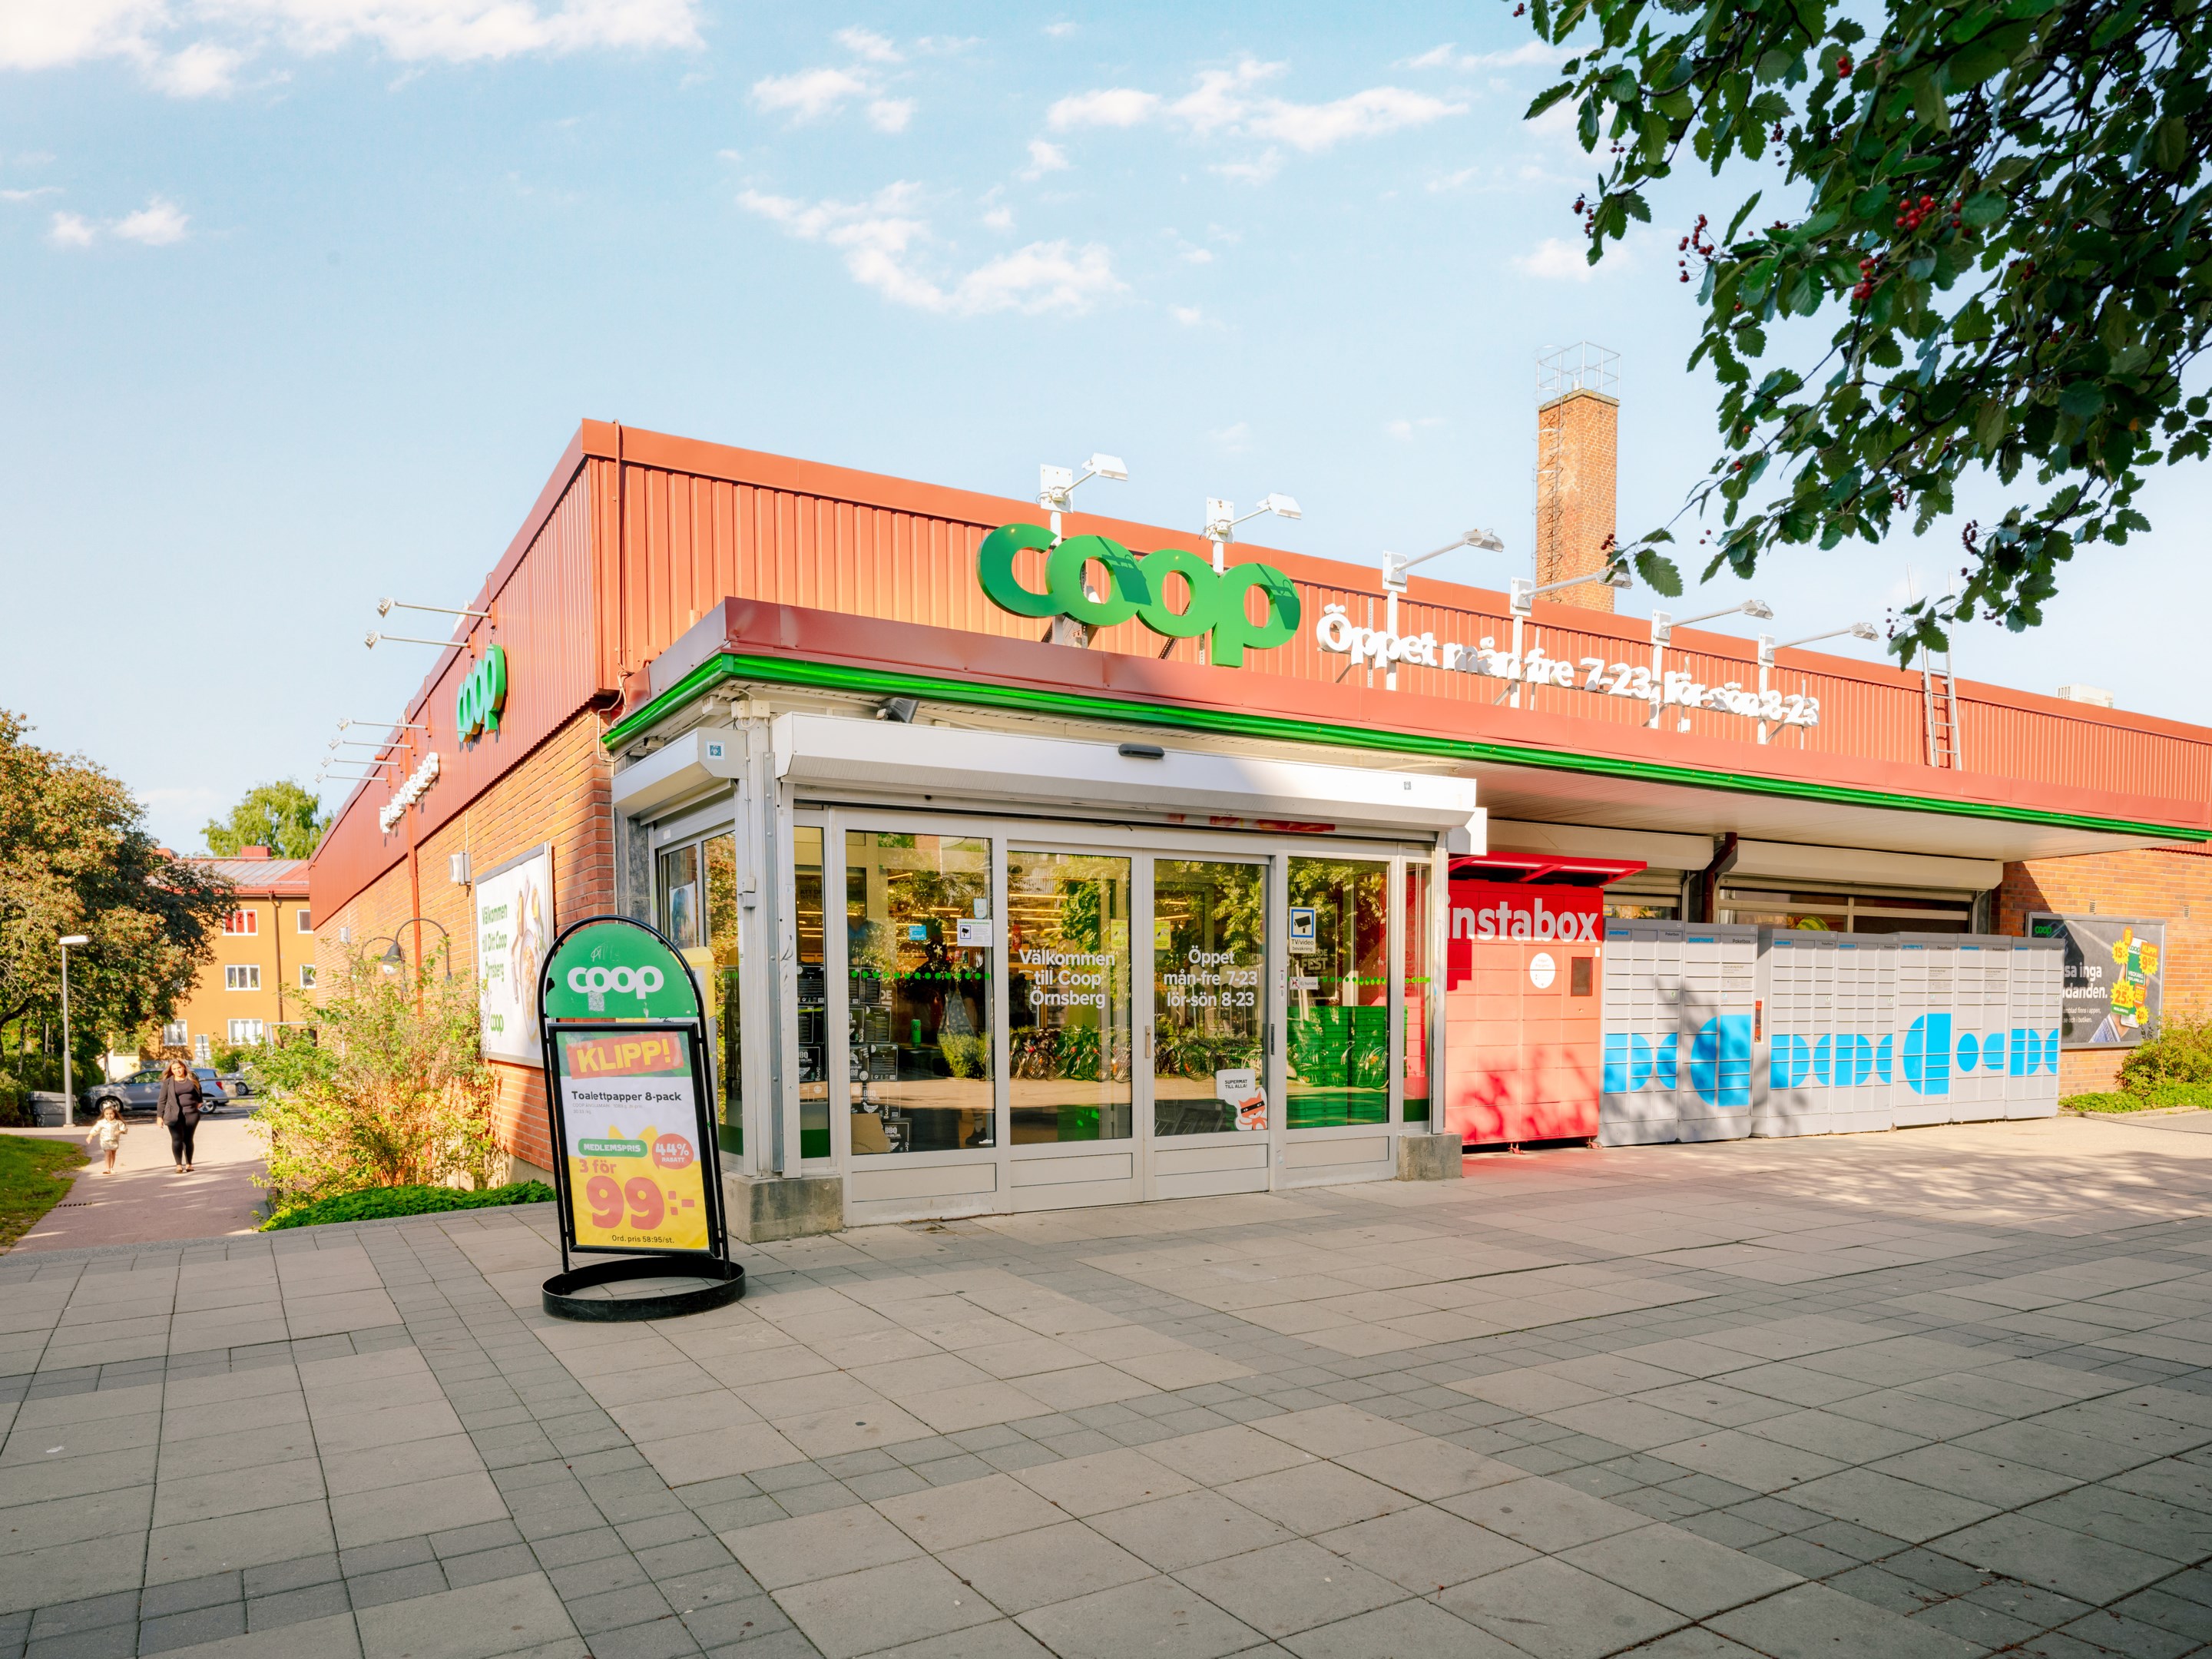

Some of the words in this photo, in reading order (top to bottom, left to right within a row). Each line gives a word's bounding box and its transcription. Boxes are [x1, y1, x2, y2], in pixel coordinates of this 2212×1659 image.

[976, 523, 1300, 667] coop
[1316, 603, 1437, 669] Öppet
[456, 644, 506, 743] coop
[482, 904, 507, 926] Välkommen
[496, 930, 507, 952] Coop
[2035, 926, 2052, 935] coop
[1018, 949, 1115, 965] Välkommen
[1188, 945, 1234, 968] Öppet
[1301, 957, 1328, 970] FEST
[567, 965, 664, 999] coop
[1035, 970, 1053, 985] till
[1058, 970, 1101, 988] Coop
[1164, 969, 1220, 985] mån-fre
[1227, 971, 1257, 985] 7-23
[2065, 965, 2077, 978] sa
[2080, 962, 2102, 982] inga
[1030, 986, 1105, 1008] Örnsberg
[1167, 992, 1217, 1006] lör-sön
[1221, 992, 1254, 1006] 8-23
[490, 1013, 504, 1037] coop
[577, 1038, 671, 1073] KLIPP!
[571, 1091, 642, 1102] Toalettpapper
[645, 1091, 682, 1102] 8-pack
[583, 1143, 641, 1152] MEDLEMSPRIS
[655, 1143, 689, 1156] 44%
[579, 1159, 588, 1174] 3
[592, 1160, 617, 1174] för
[586, 1175, 694, 1230] 99:-
